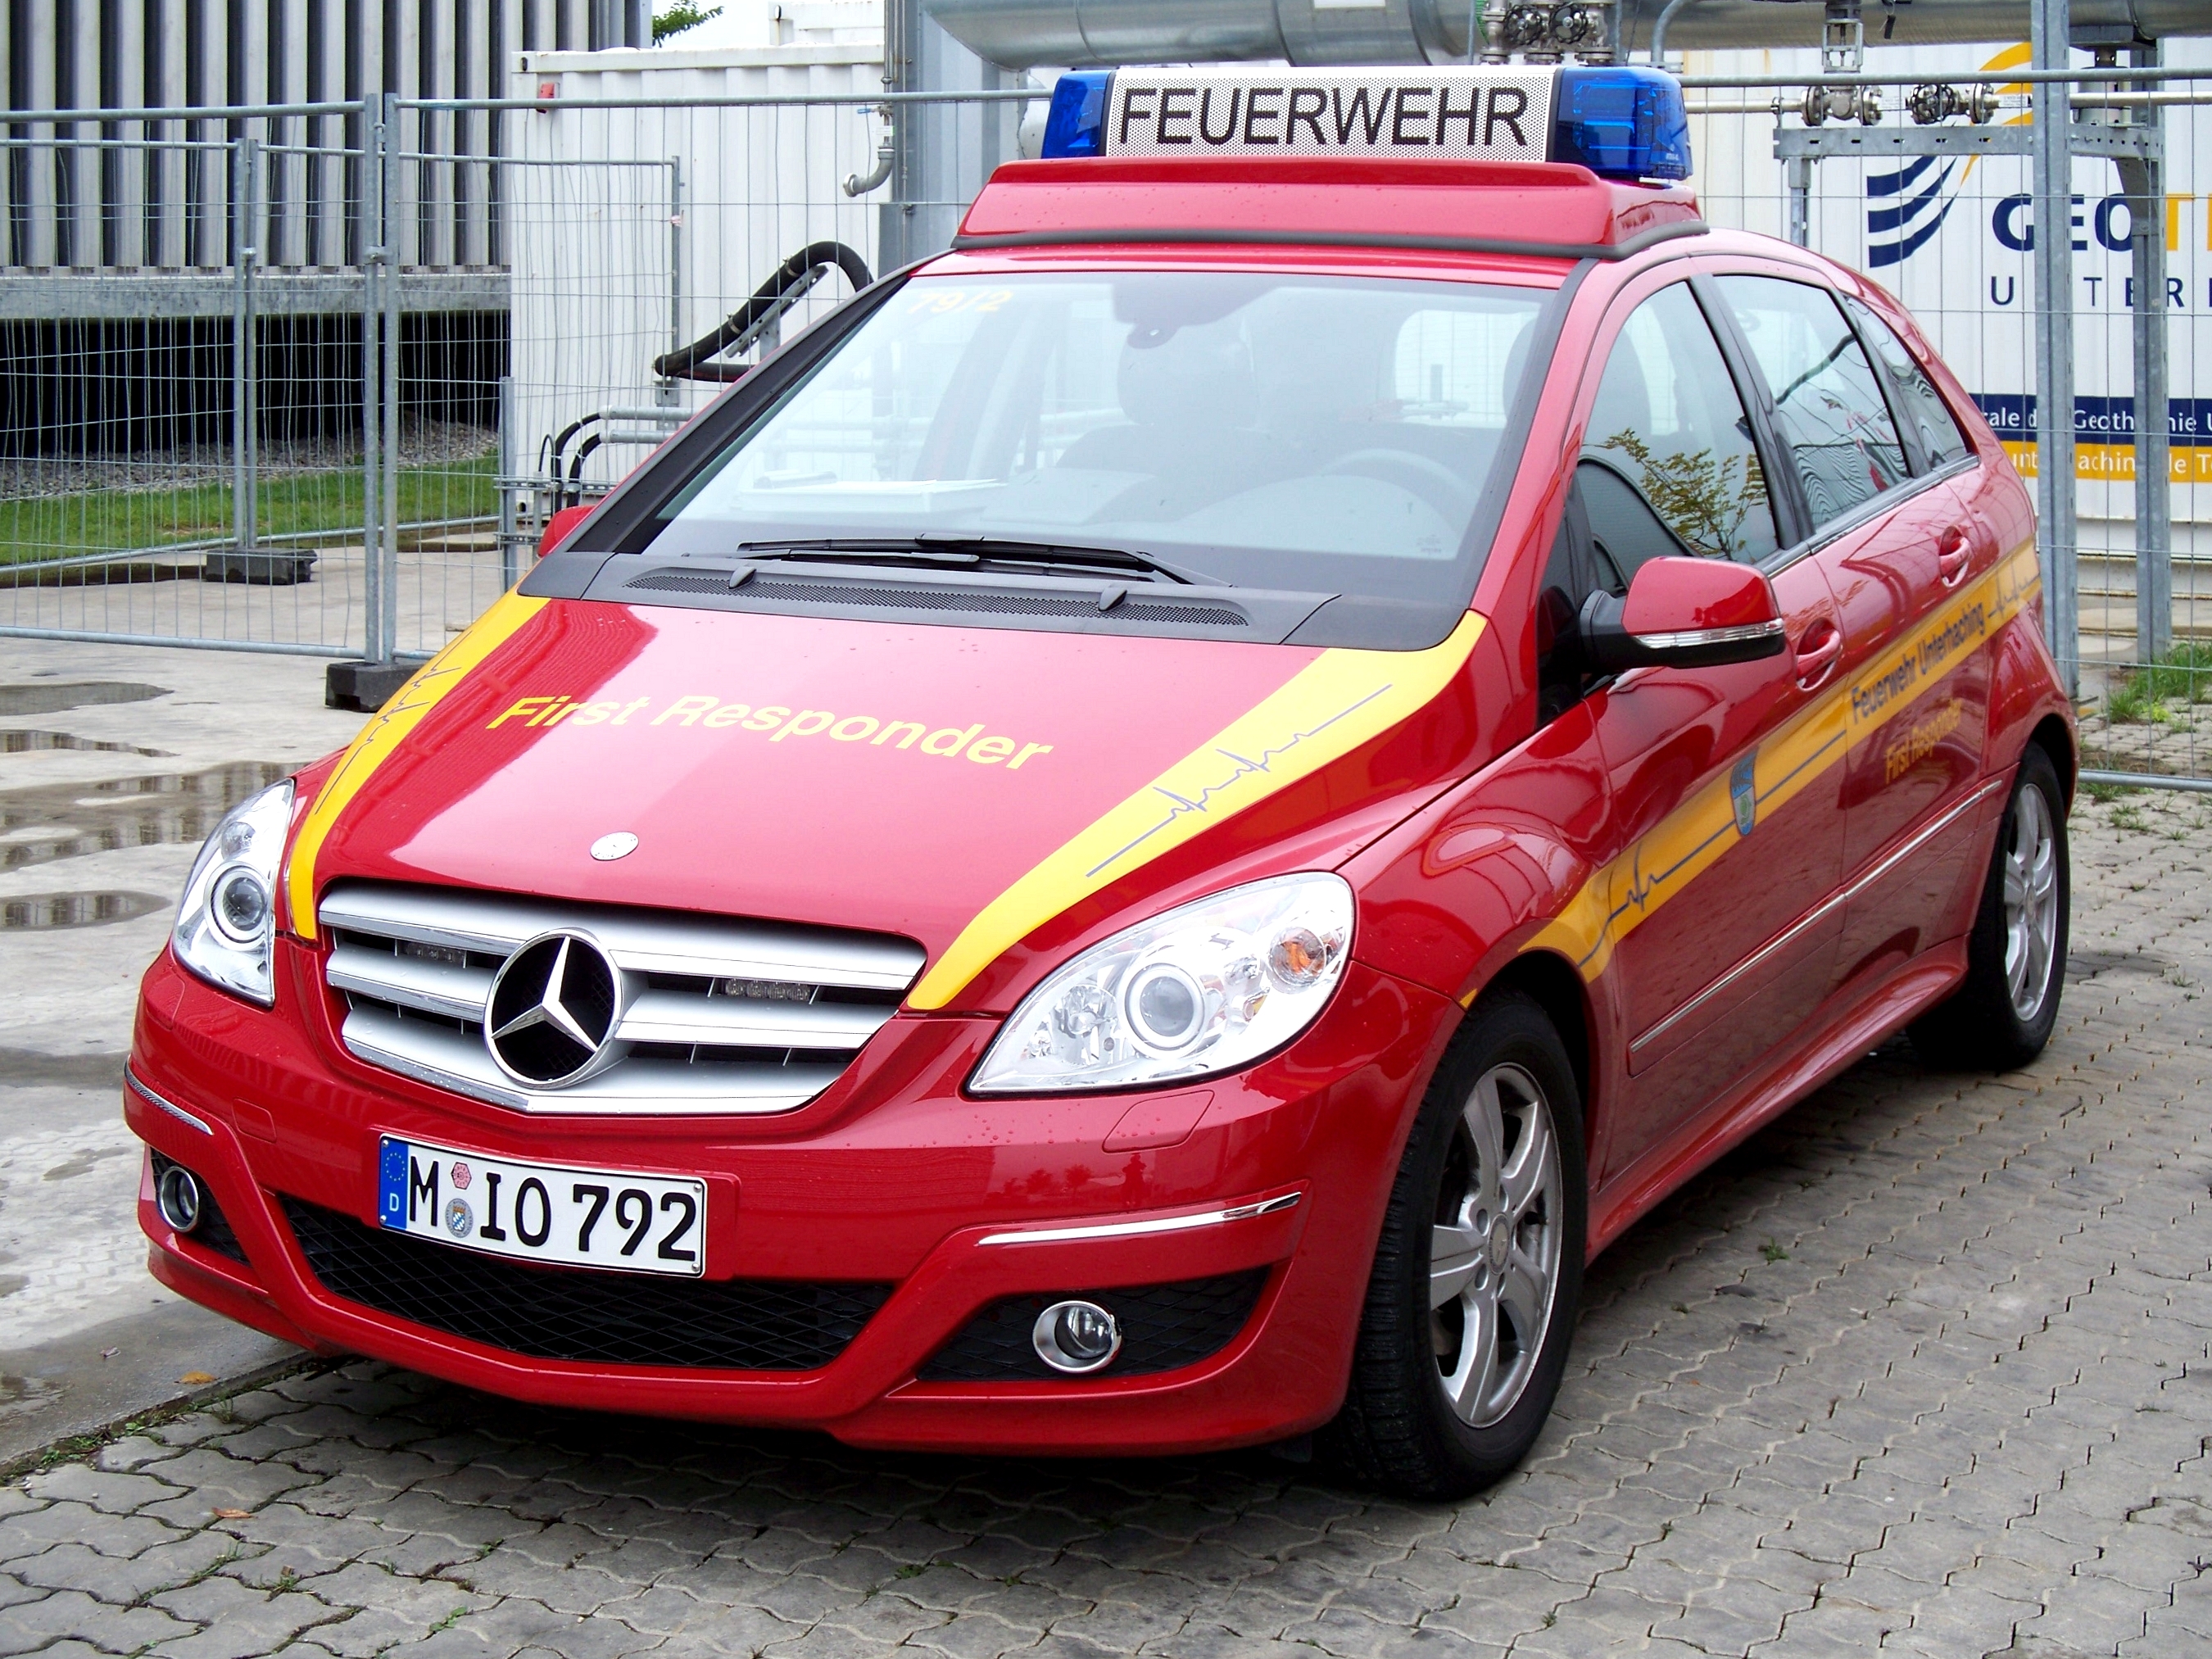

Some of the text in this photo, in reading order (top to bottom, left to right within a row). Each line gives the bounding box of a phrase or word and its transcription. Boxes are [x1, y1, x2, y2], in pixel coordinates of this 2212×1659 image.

[1119, 87, 1530, 146] FEUERWEHR
[1992, 193, 2212, 252] GEOT
[907, 290, 1013, 314] 79/2
[1852, 602, 1985, 724] Feuerwehr Unterhaching
[486, 695, 1054, 770] First Responder
[1886, 737, 1910, 784] First
[389, 1193, 399, 1212] D
[410, 1156, 438, 1226] M
[480, 1172, 551, 1247] IO
[573, 1183, 696, 1262] 792
